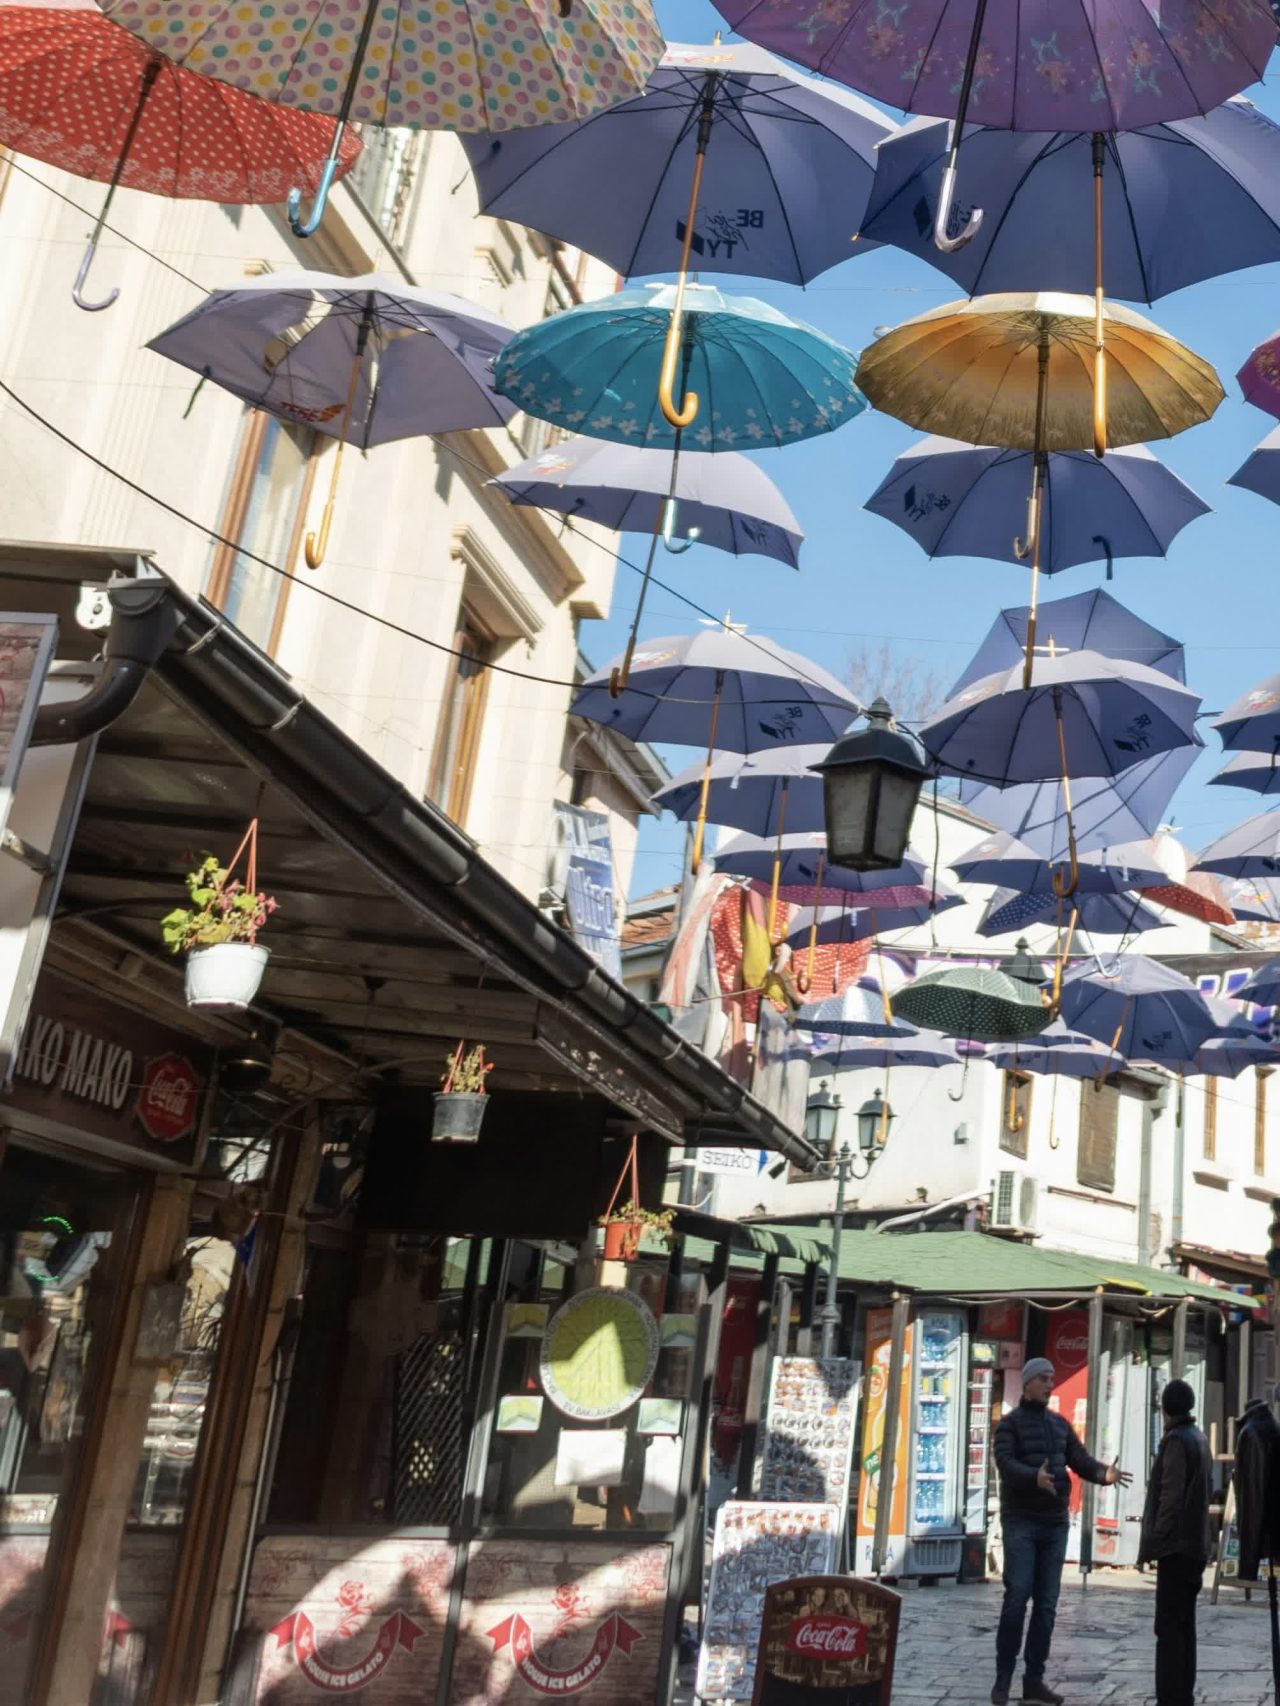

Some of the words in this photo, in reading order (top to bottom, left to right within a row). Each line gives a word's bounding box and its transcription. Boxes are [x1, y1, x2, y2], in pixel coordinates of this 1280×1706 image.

[61, 1029, 134, 1110] MAKO
[702, 1149, 753, 1170] SEIKO
[795, 1622, 860, 1653] Coca-Cola
[346, 1652, 384, 1685] GELATO
[564, 1654, 602, 1687] GELATO
